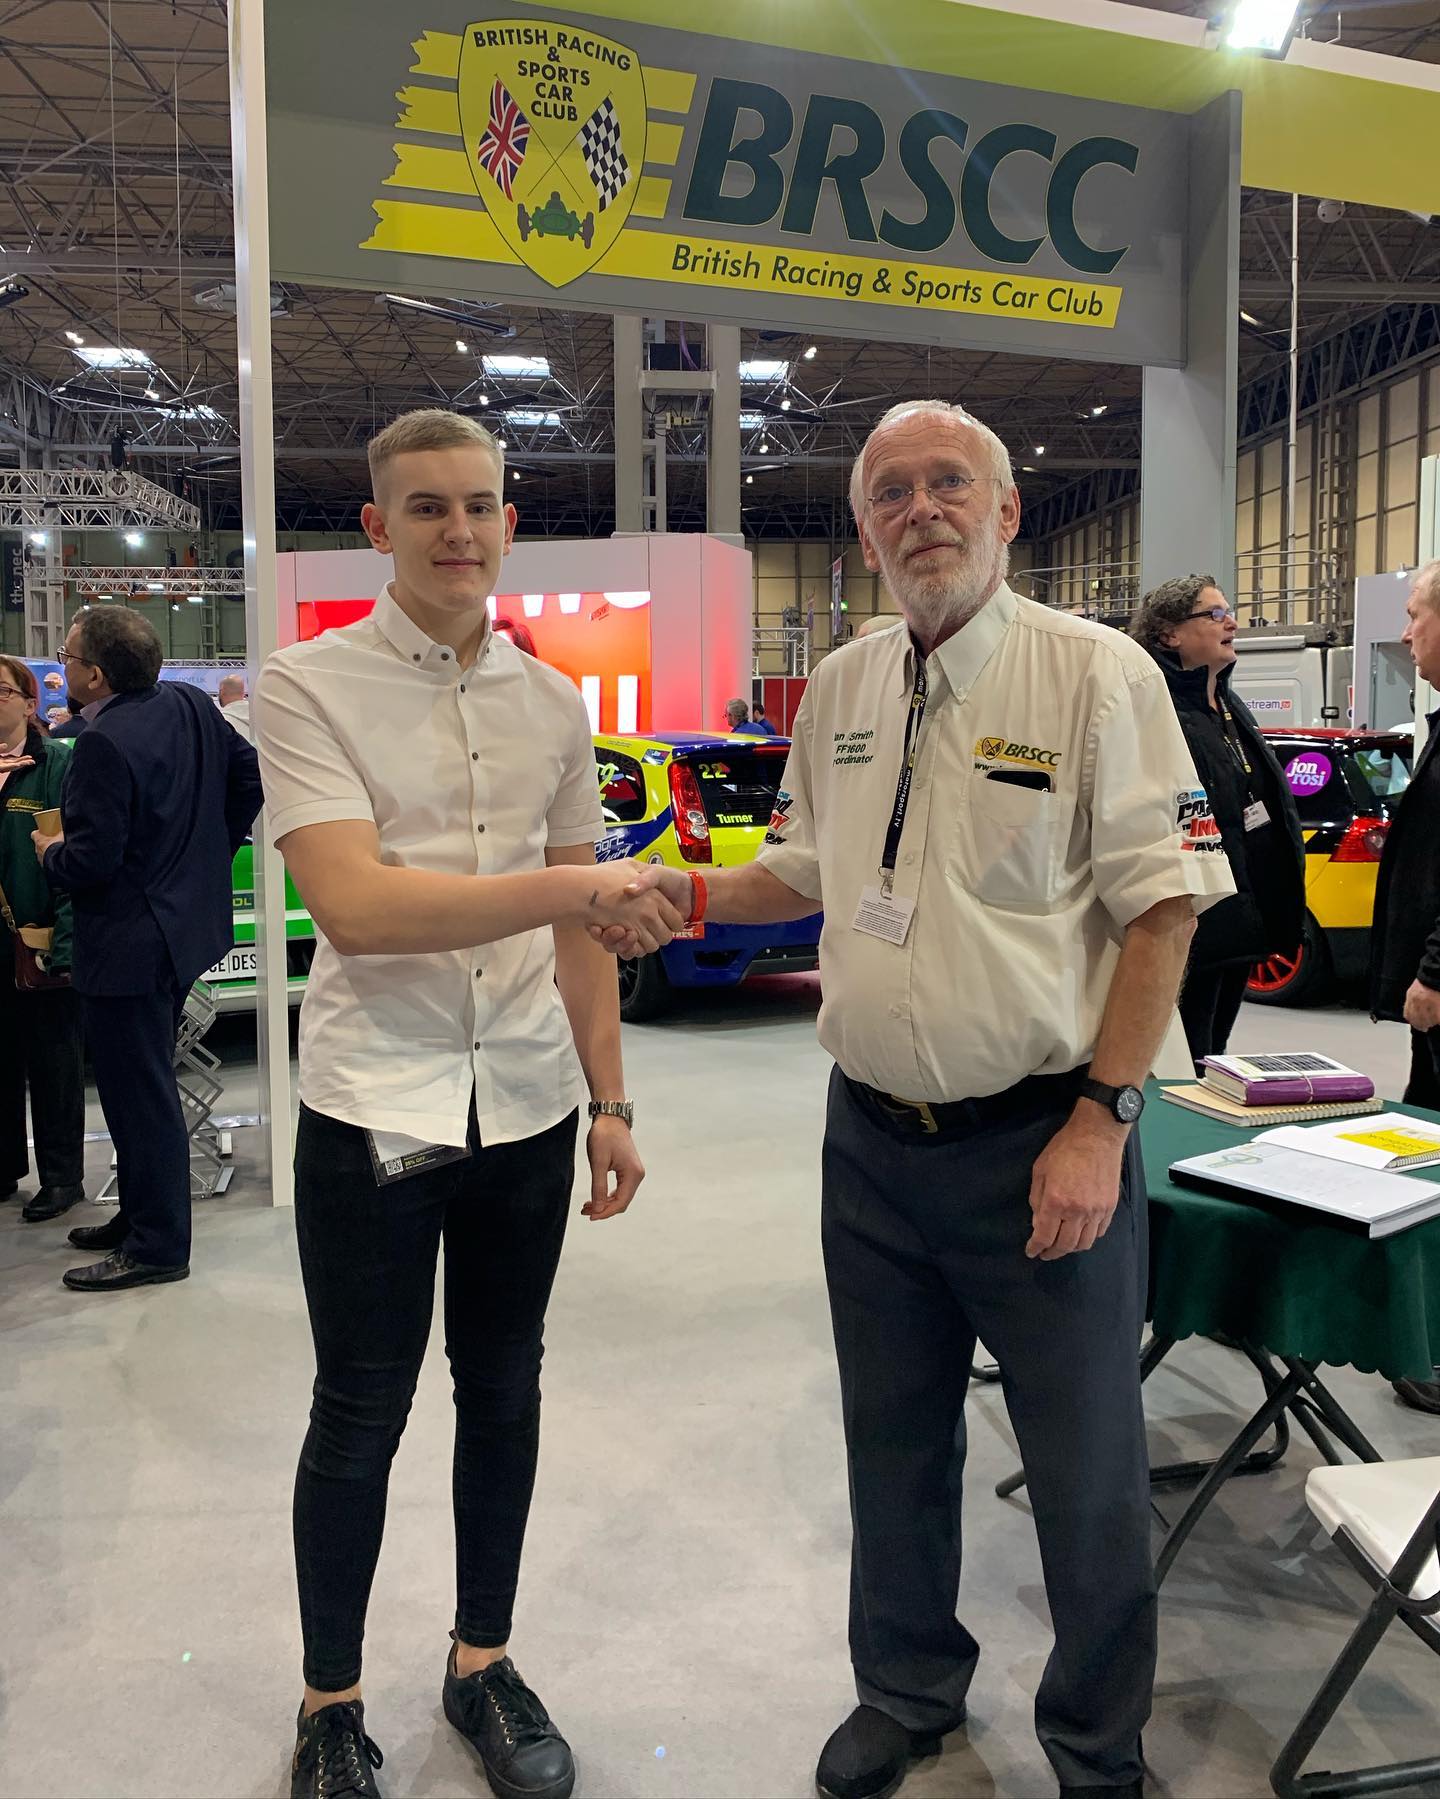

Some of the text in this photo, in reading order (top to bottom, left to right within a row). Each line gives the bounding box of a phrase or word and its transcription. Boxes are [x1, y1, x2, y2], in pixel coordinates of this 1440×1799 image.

[473, 28, 631, 71] BRITISH RACING
[546, 46, 561, 62] &
[517, 60, 591, 86] SPORTS
[535, 82, 573, 102] CAR
[530, 100, 578, 122] CLUB
[682, 76, 1140, 275] BRSCC
[671, 244, 1104, 318] British Racing & Sports Car Club
[849, 730, 874, 741] Smith
[836, 744, 866, 754] FF1600
[1004, 743, 1062, 767] BRSCC
[698, 763, 728, 779] 22
[1286, 758, 1318, 778] jon
[1291, 771, 1326, 787] rosi
[716, 813, 754, 824] Turner
